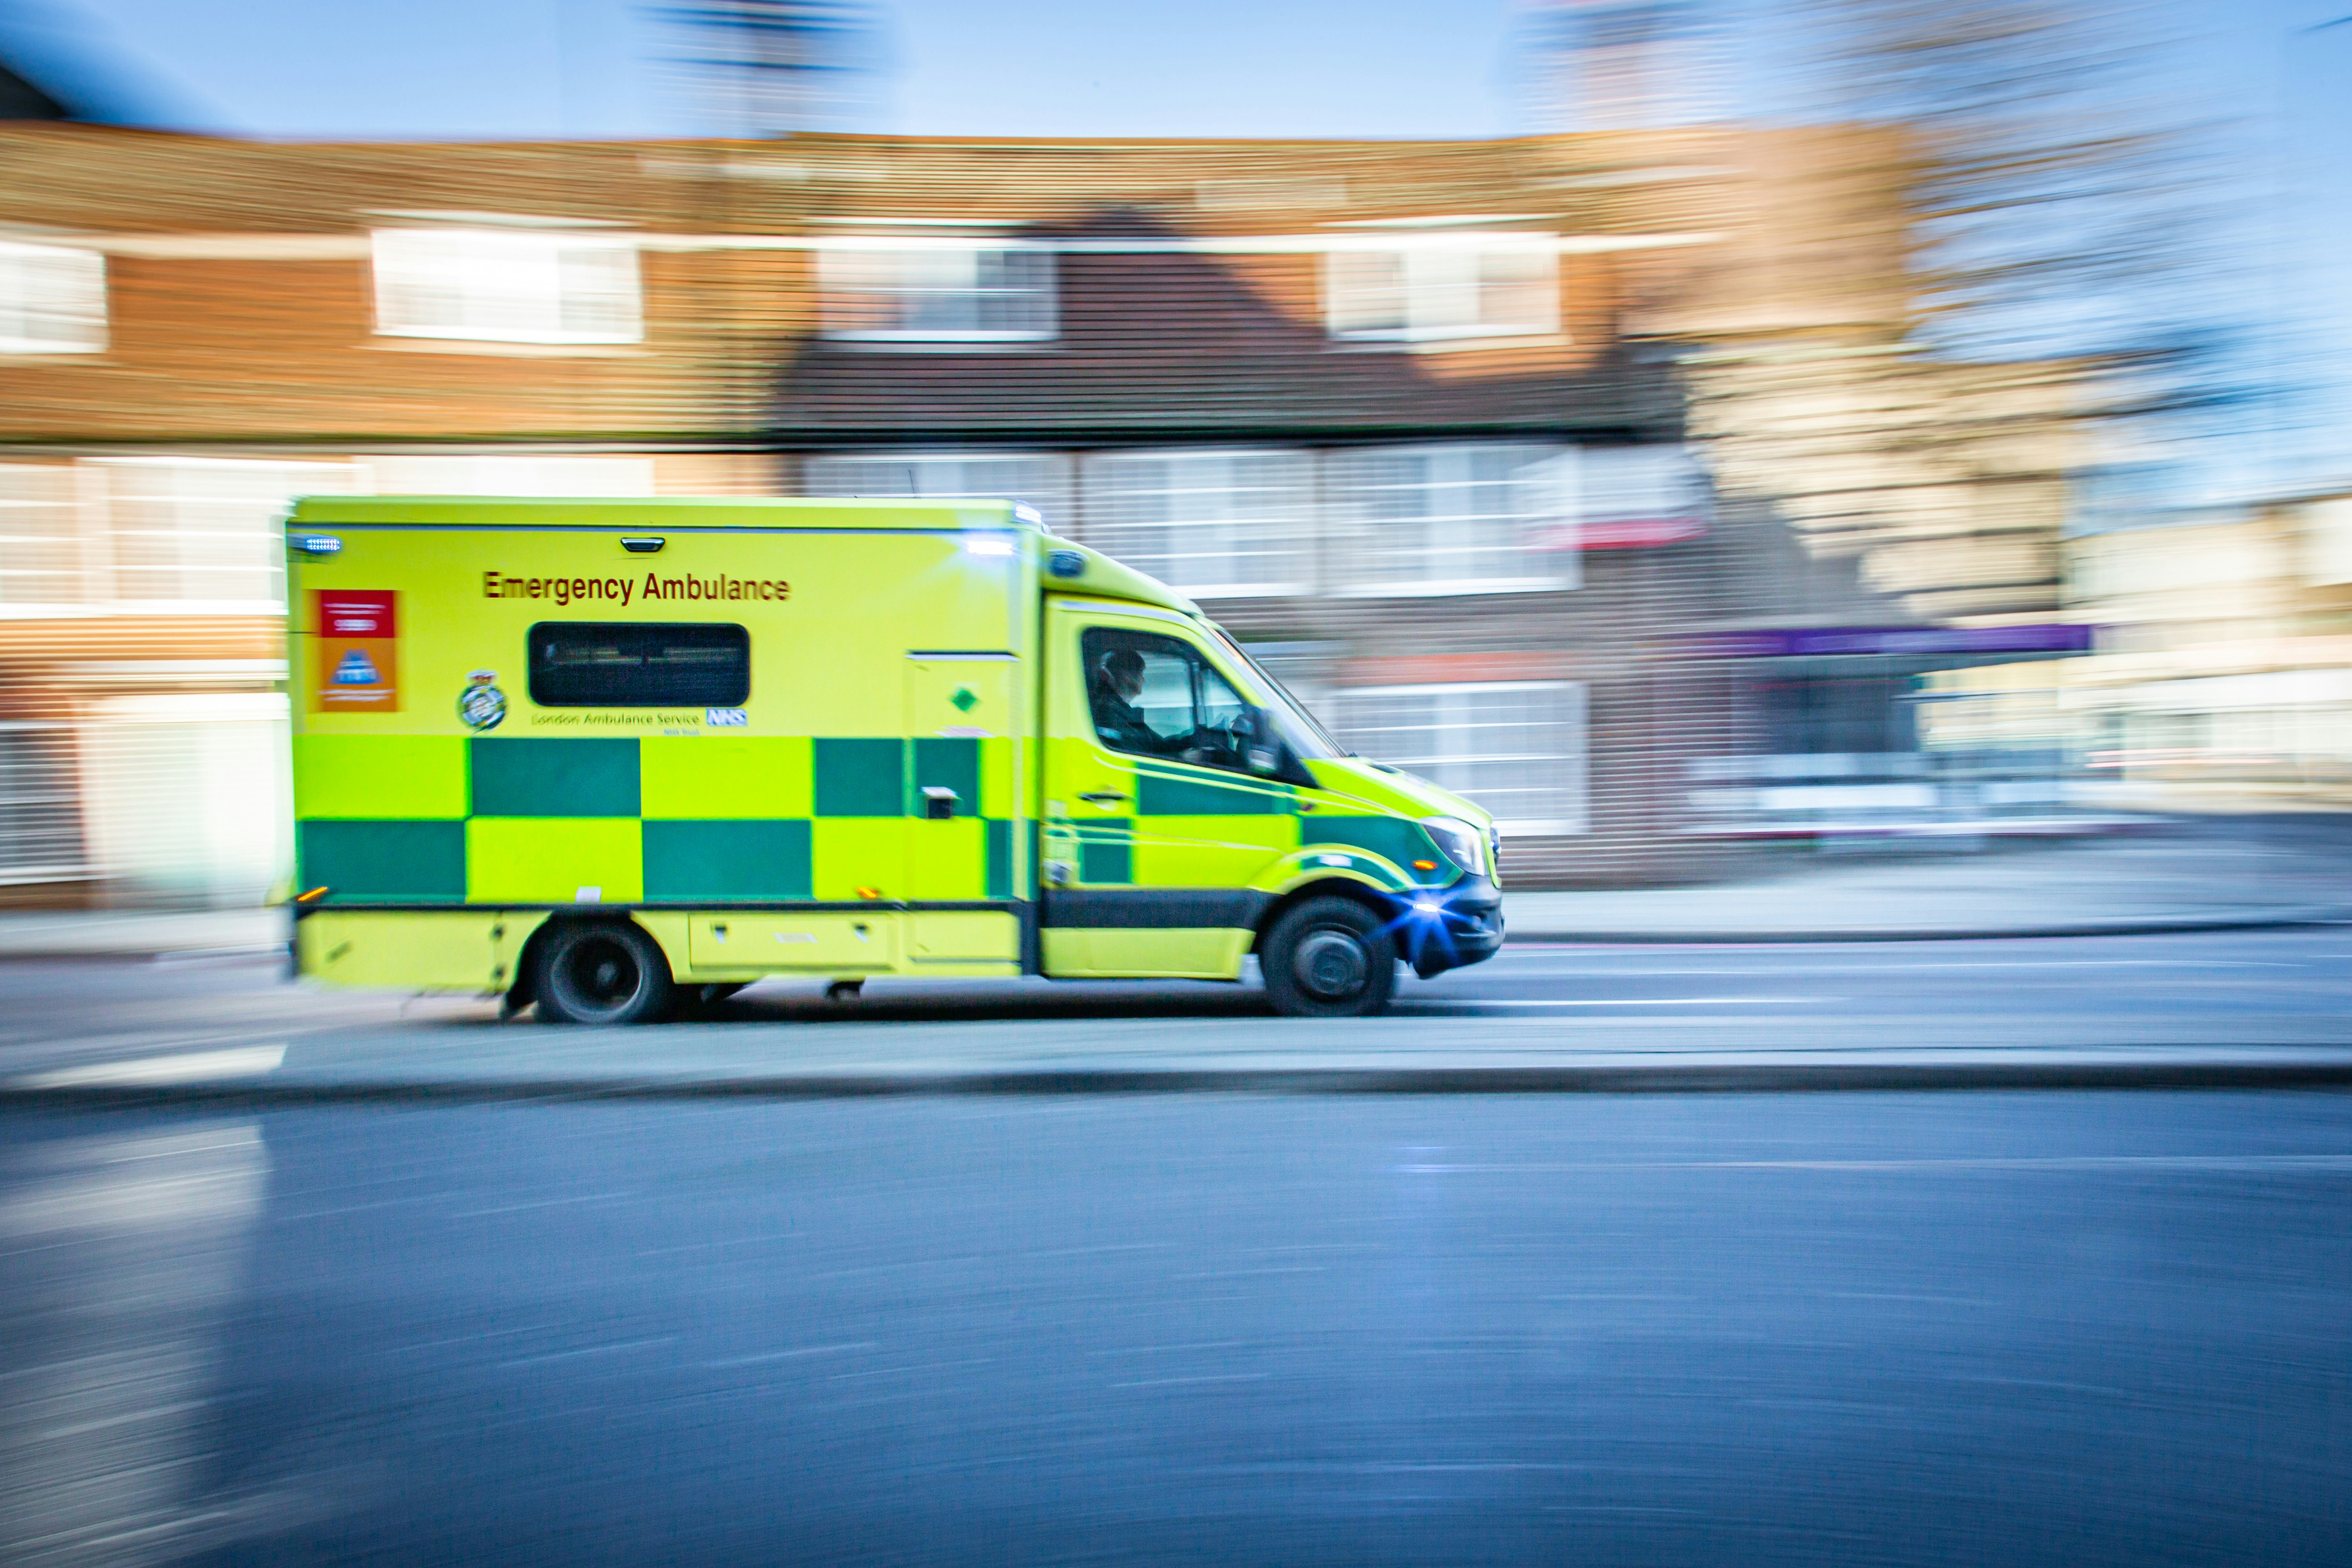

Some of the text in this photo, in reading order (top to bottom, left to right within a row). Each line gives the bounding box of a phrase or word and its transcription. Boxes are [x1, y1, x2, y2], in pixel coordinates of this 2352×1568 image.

[482, 571, 790, 606] Emergency Ambulance
[532, 713, 700, 726] London Ambulance Service
[707, 709, 746, 726] NHS
